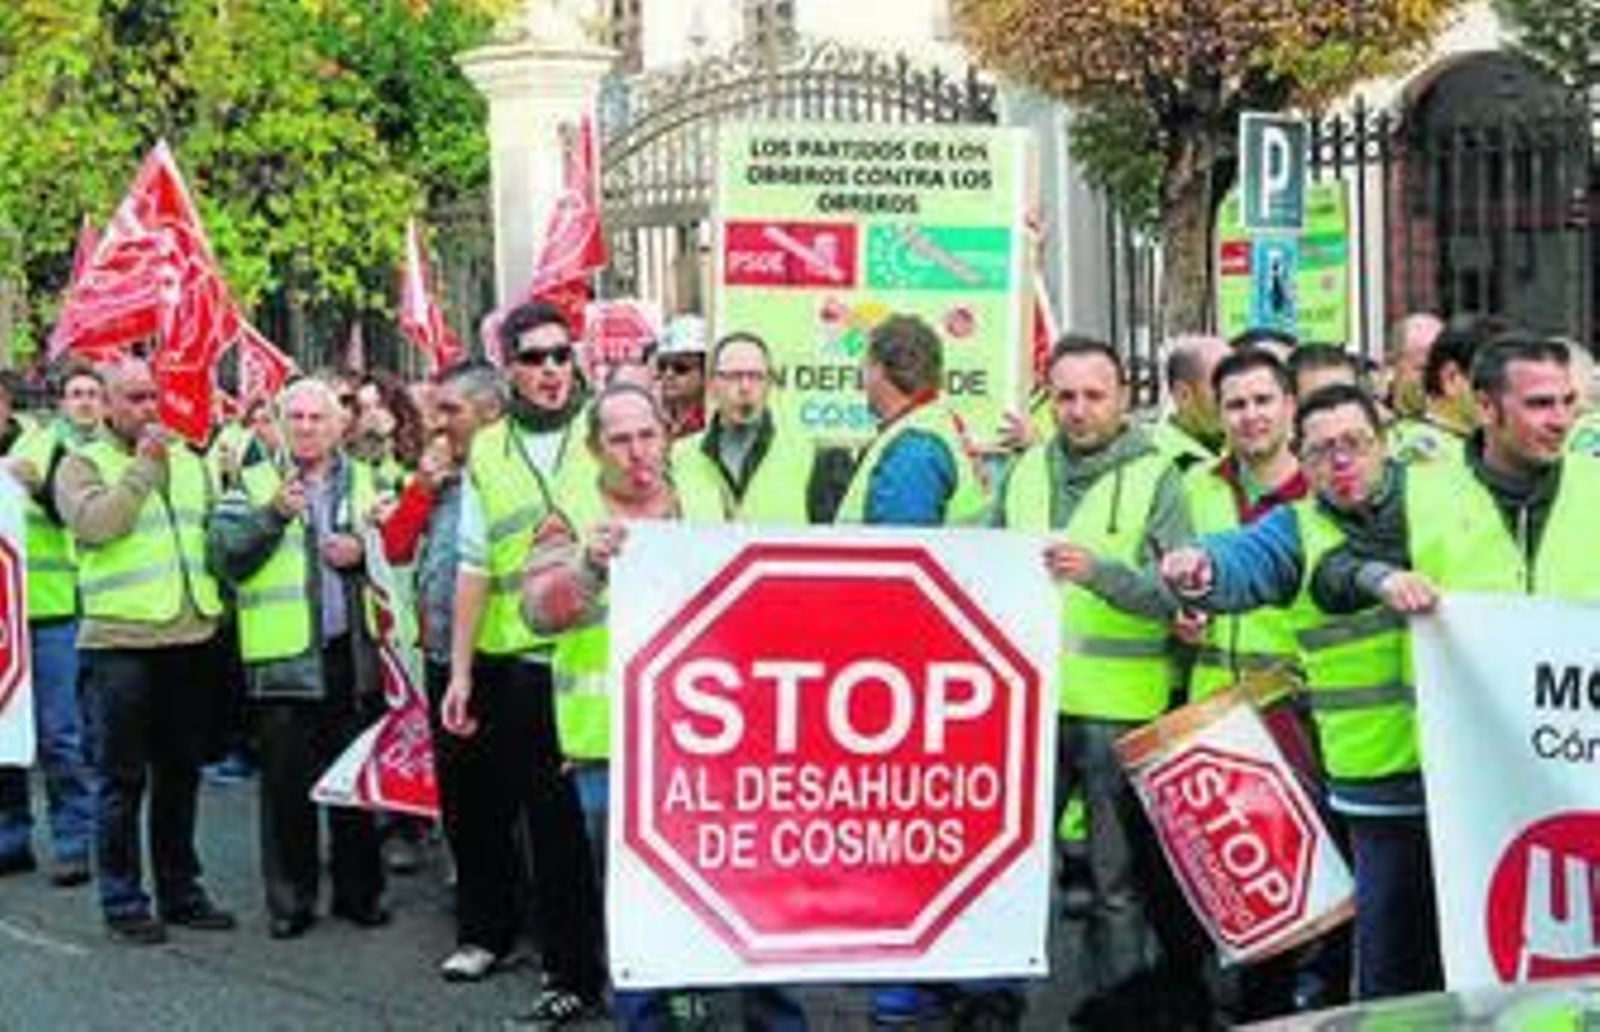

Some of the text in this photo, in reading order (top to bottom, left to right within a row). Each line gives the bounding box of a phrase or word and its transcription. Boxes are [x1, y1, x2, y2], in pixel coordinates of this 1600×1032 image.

[750, 139, 989, 162] LOS PARTIDOS DE LOS
[1260, 126, 1290, 219] P
[747, 165, 993, 189] OBREROS CONTRA LOS
[816, 192, 919, 214] OBREROS
[947, 370, 988, 396] DE
[670, 658, 996, 756] STOP
[664, 764, 1000, 812] AL DESAHUCIO
[698, 819, 966, 869] DE COSMOS
[1181, 767, 1290, 908] STOP
